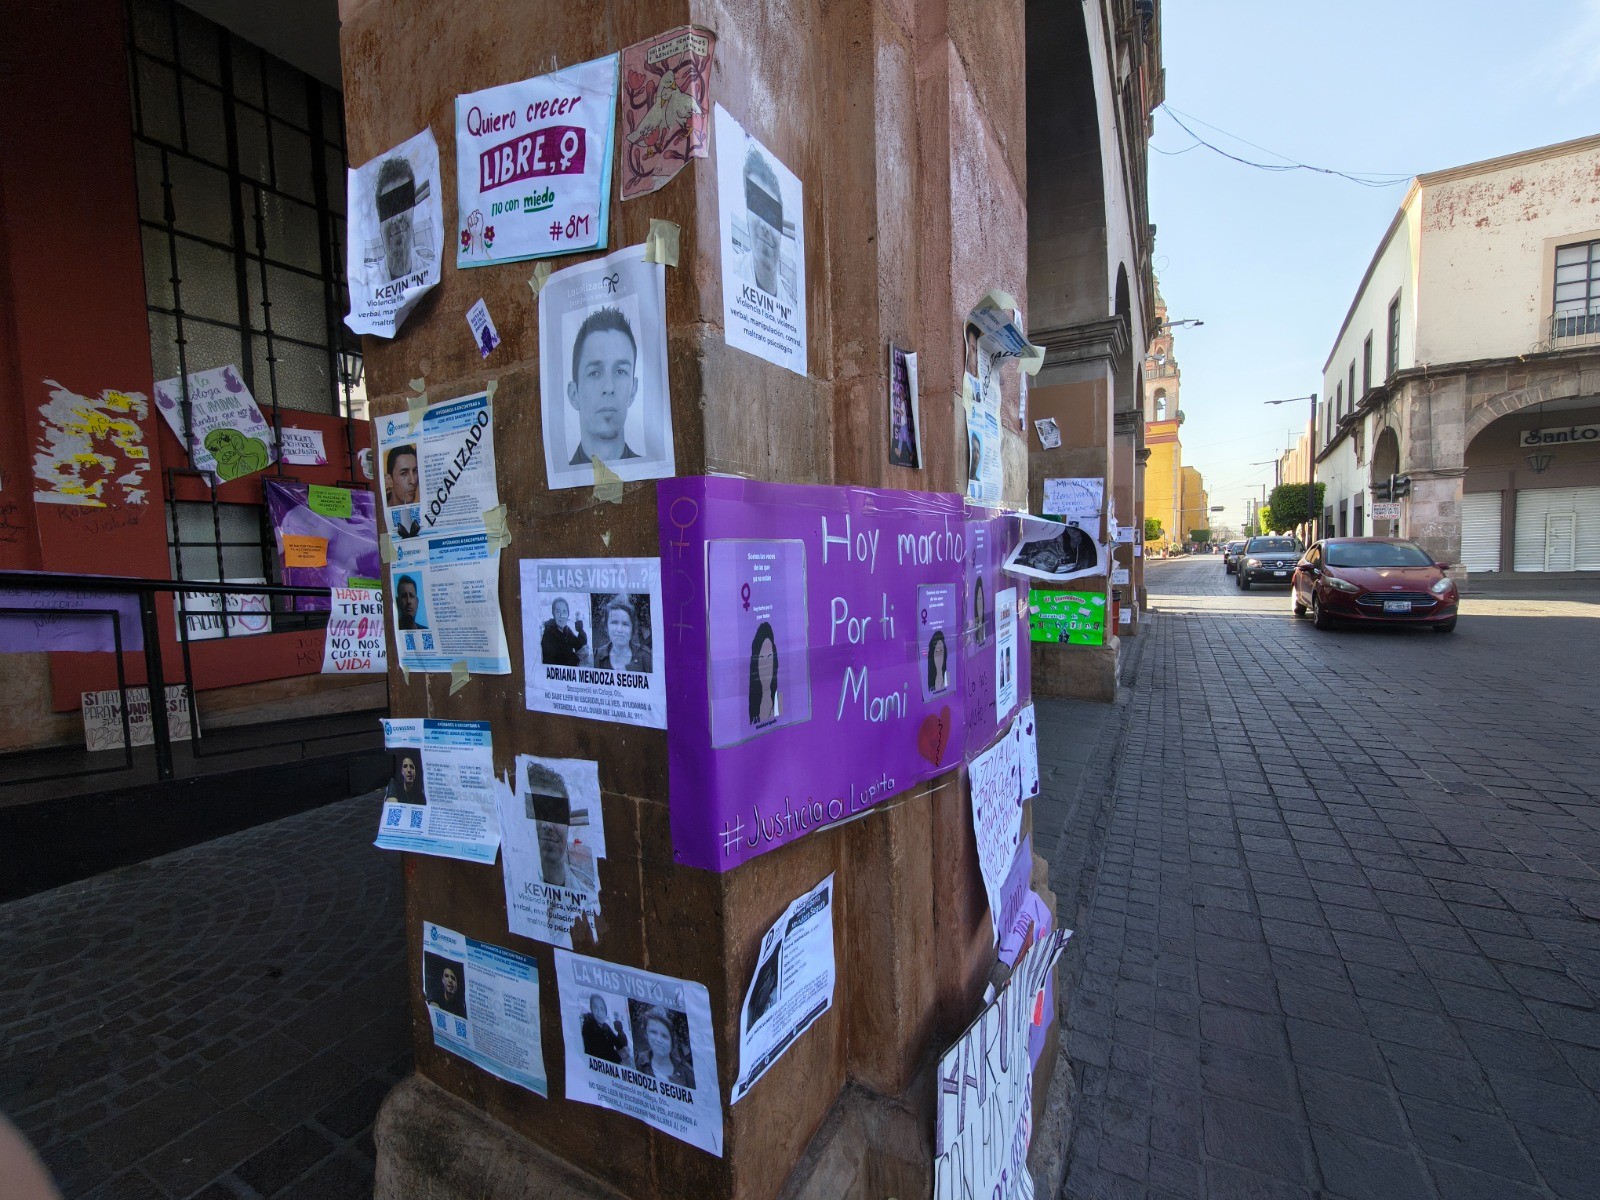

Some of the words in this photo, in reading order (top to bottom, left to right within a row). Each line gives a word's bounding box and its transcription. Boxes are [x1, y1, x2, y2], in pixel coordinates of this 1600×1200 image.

[467, 106, 516, 136] Quiero
[526, 96, 582, 123] crecer
[482, 134, 556, 186] LIBRE,
[491, 200, 503, 216] no
[504, 199, 519, 213] con
[523, 186, 555, 209] miedo
[375, 281, 409, 300] KEVIN
[742, 283, 774, 313] KEVIN
[366, 298, 396, 307] Violencia
[736, 295, 761, 315] Violencia
[371, 319, 396, 327] maltra
[730, 307, 750, 323] verbal,
[743, 327, 766, 343] maltrato
[424, 410, 489, 528] LOCALIZADO
[821, 513, 880, 575] Hoy
[538, 568, 557, 589] LA
[557, 568, 585, 590] HAS
[336, 587, 370, 601] HASTA
[338, 603, 384, 616] TENER
[830, 596, 872, 646] Por
[879, 592, 896, 641] ti
[331, 650, 372, 660] CUESTE
[332, 638, 351, 650] NO
[358, 639, 380, 650] NOS
[335, 657, 371, 671] VIDA
[546, 666, 577, 683] ADRIANA
[578, 671, 615, 687] MENDOZA
[616, 674, 650, 690] SEGURA
[836, 665, 909, 723] Mami
[850, 772, 896, 812] Lupita
[524, 881, 562, 902] KEVIN
[573, 962, 592, 985] LA
[593, 968, 620, 992] HAS
[588, 1057, 621, 1082] ADRIANA
[621, 1068, 658, 1095] MENDOZA
[659, 1081, 694, 1106] SEGURA
